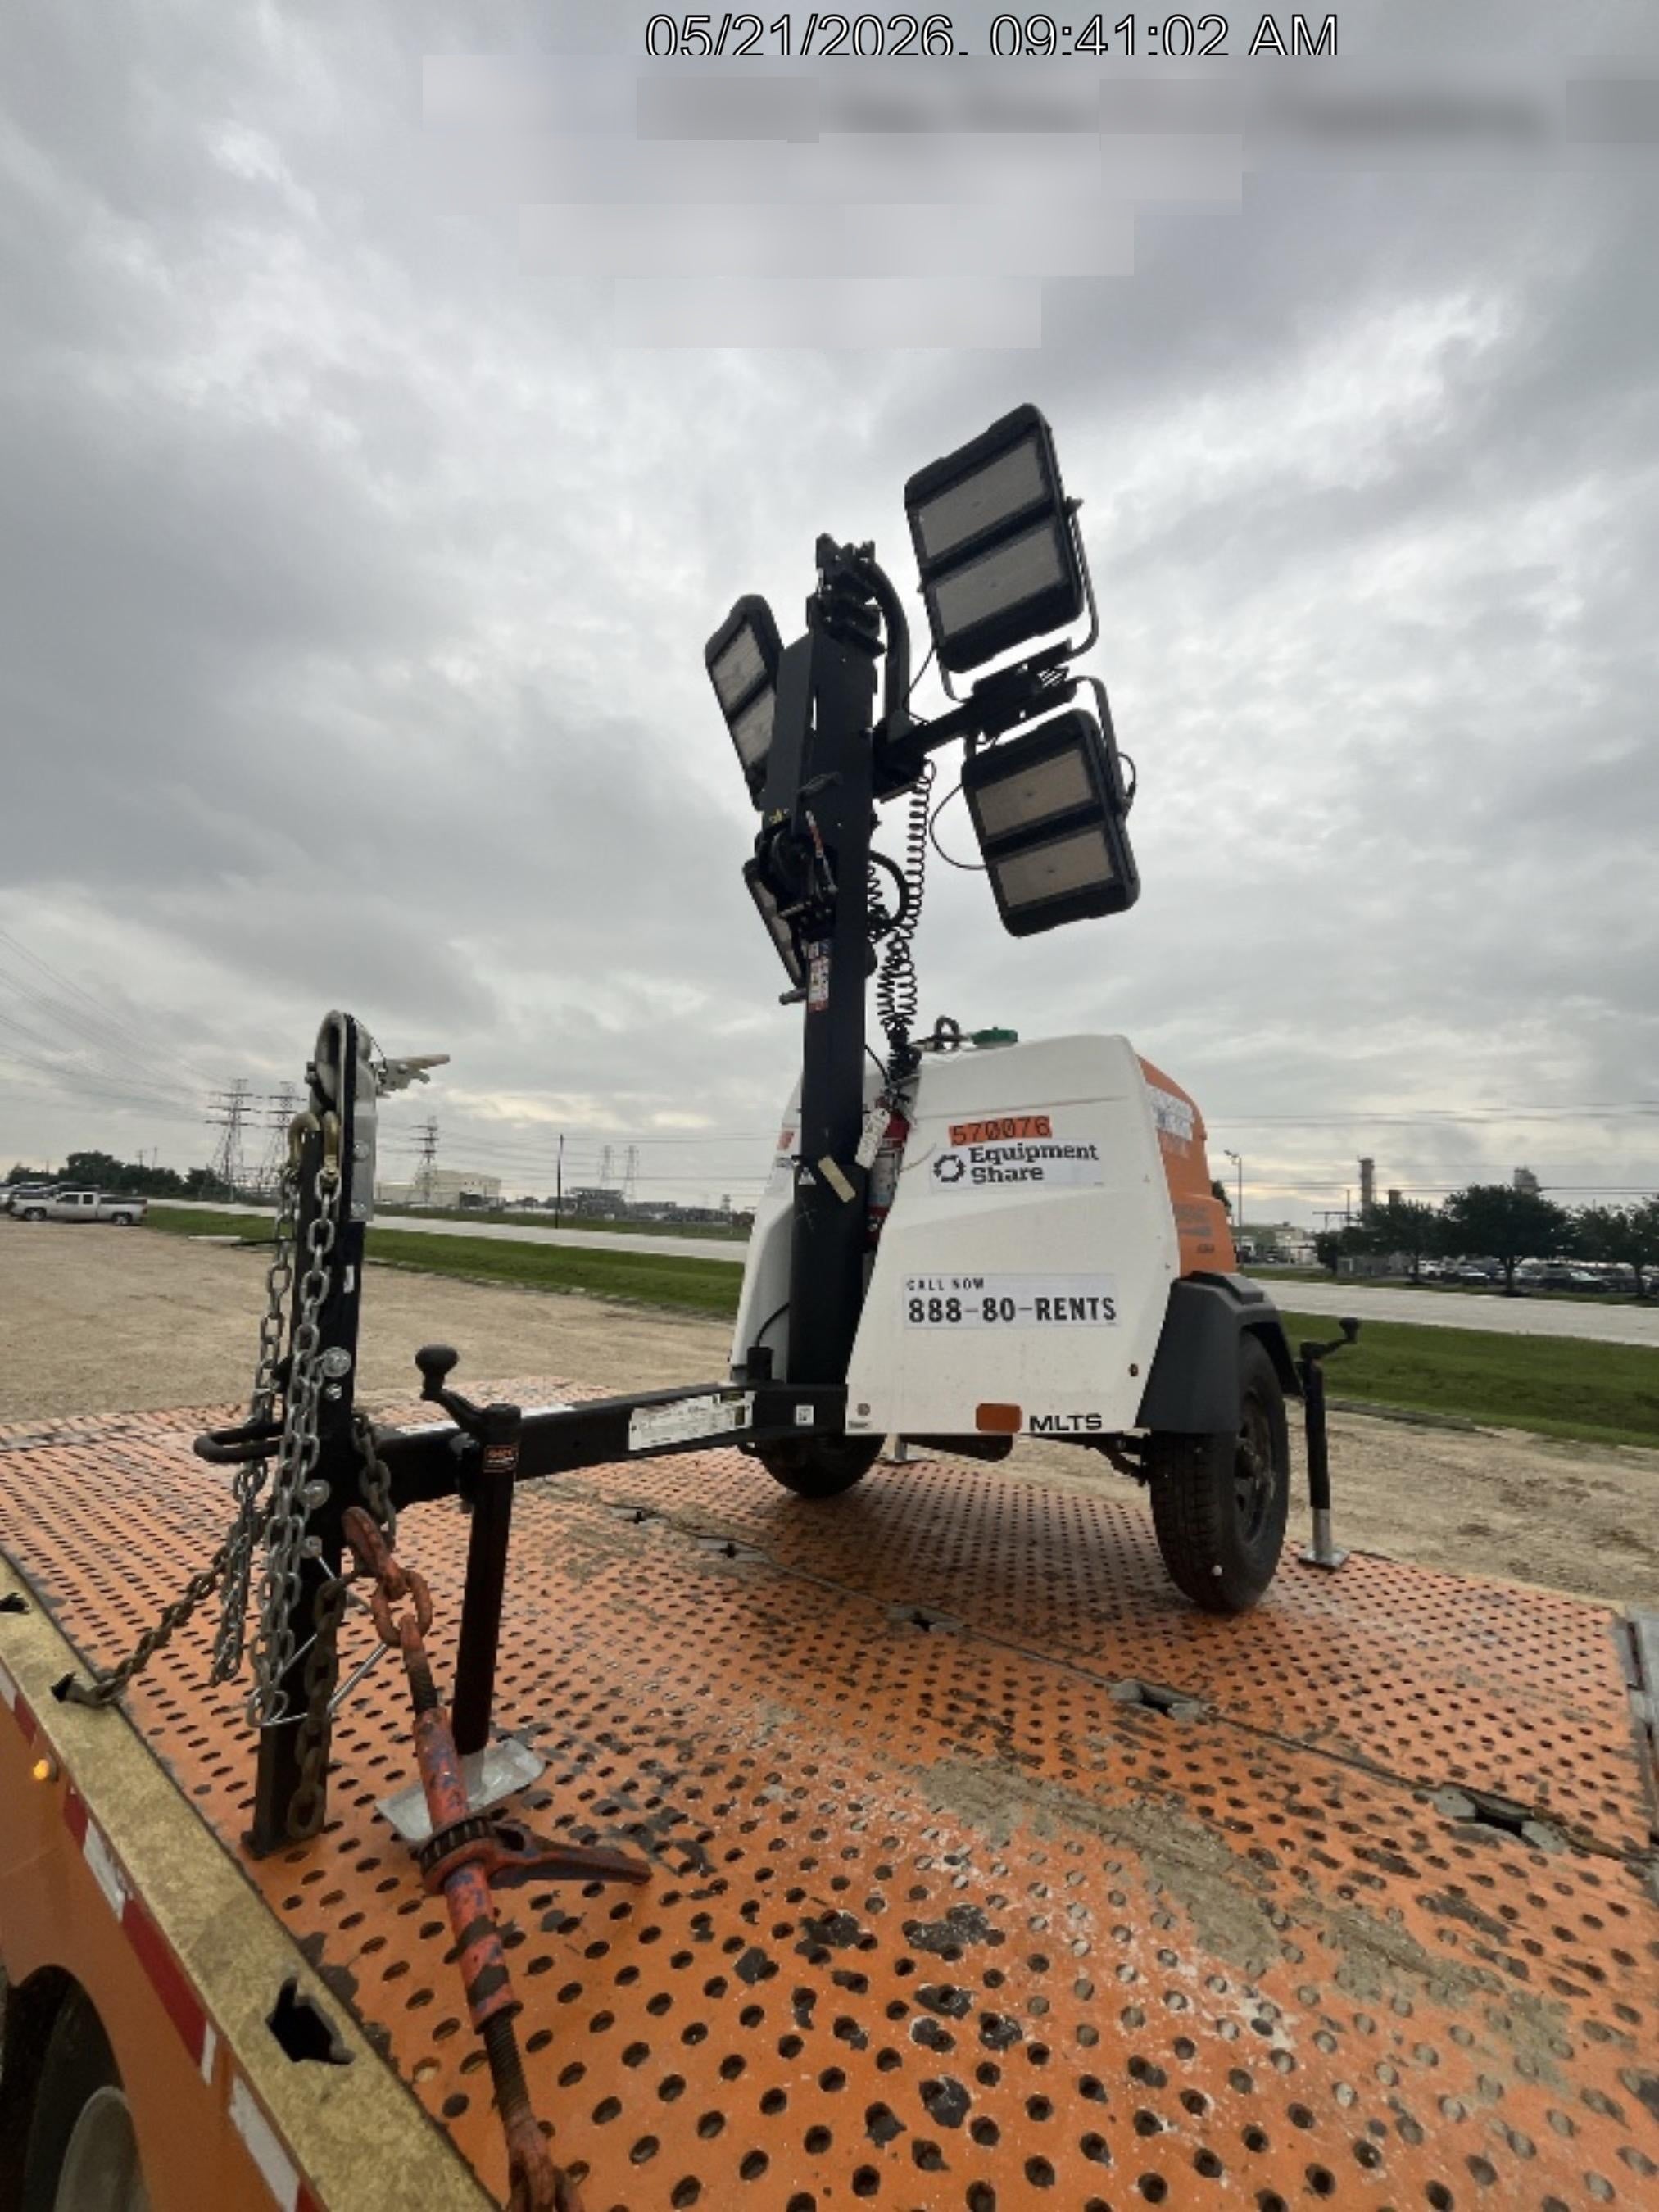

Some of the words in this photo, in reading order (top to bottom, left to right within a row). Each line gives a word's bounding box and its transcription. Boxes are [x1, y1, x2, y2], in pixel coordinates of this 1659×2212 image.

[951, 1116, 1050, 1145] 570076
[968, 1142, 1099, 1165] Equipment
[970, 1166, 1044, 1184] Share
[906, 1278, 945, 1291] CALL
[909, 1296, 1116, 1323] 888-80-RENTS
[1029, 1412, 1103, 1432] MLTS
